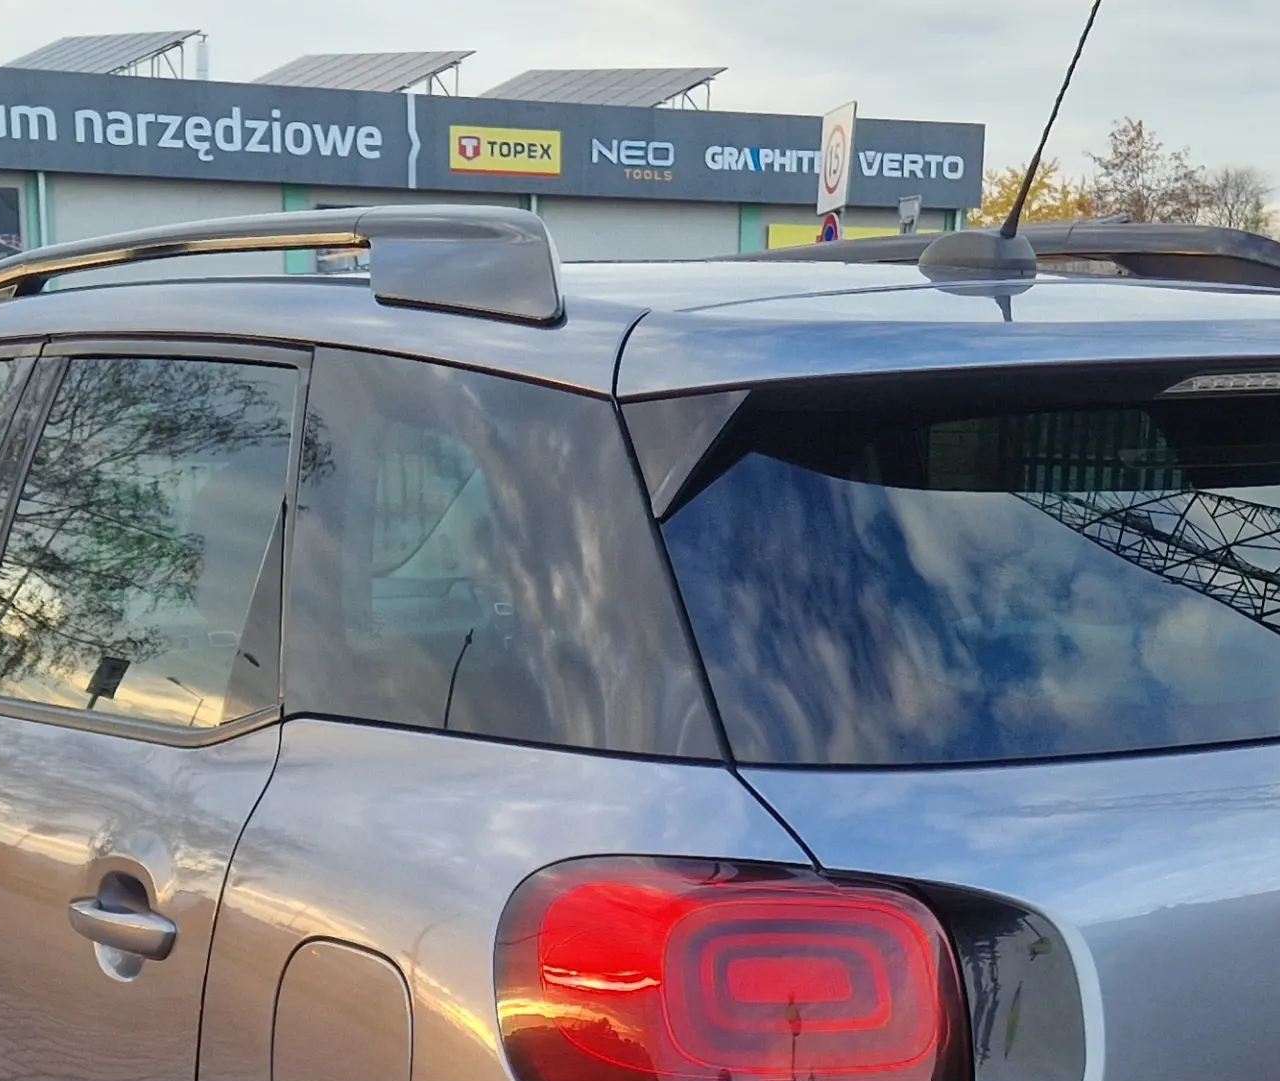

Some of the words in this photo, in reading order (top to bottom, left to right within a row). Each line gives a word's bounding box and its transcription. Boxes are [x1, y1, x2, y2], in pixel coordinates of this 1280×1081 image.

[75, 105, 383, 161] narzędziowe
[487, 140, 553, 161] TOPEX
[591, 137, 676, 167] NEO
[827, 144, 842, 179] 15
[858, 150, 965, 180] VERTO
[623, 168, 673, 182] TOOLS
